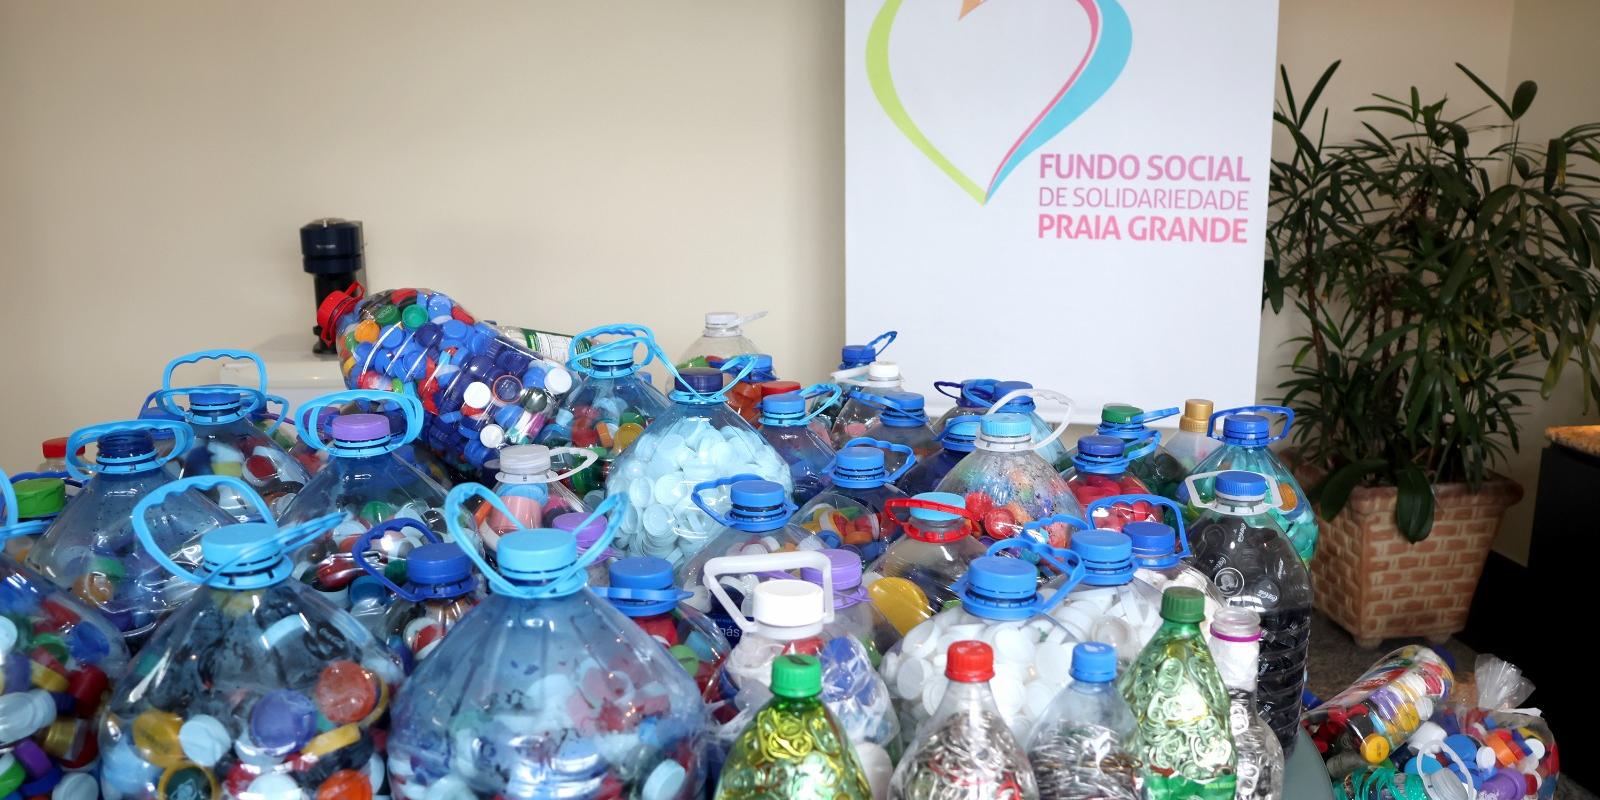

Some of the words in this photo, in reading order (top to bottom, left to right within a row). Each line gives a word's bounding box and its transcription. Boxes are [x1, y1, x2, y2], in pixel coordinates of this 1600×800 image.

[1040, 154, 1140, 180] FUNDO
[1147, 155, 1251, 182] SOCIAL
[1039, 187, 1067, 207] DE
[1073, 187, 1248, 211] SOLIDARIEDADE
[1038, 214, 1122, 240] PRAIA
[1128, 216, 1248, 243] GRANDE
